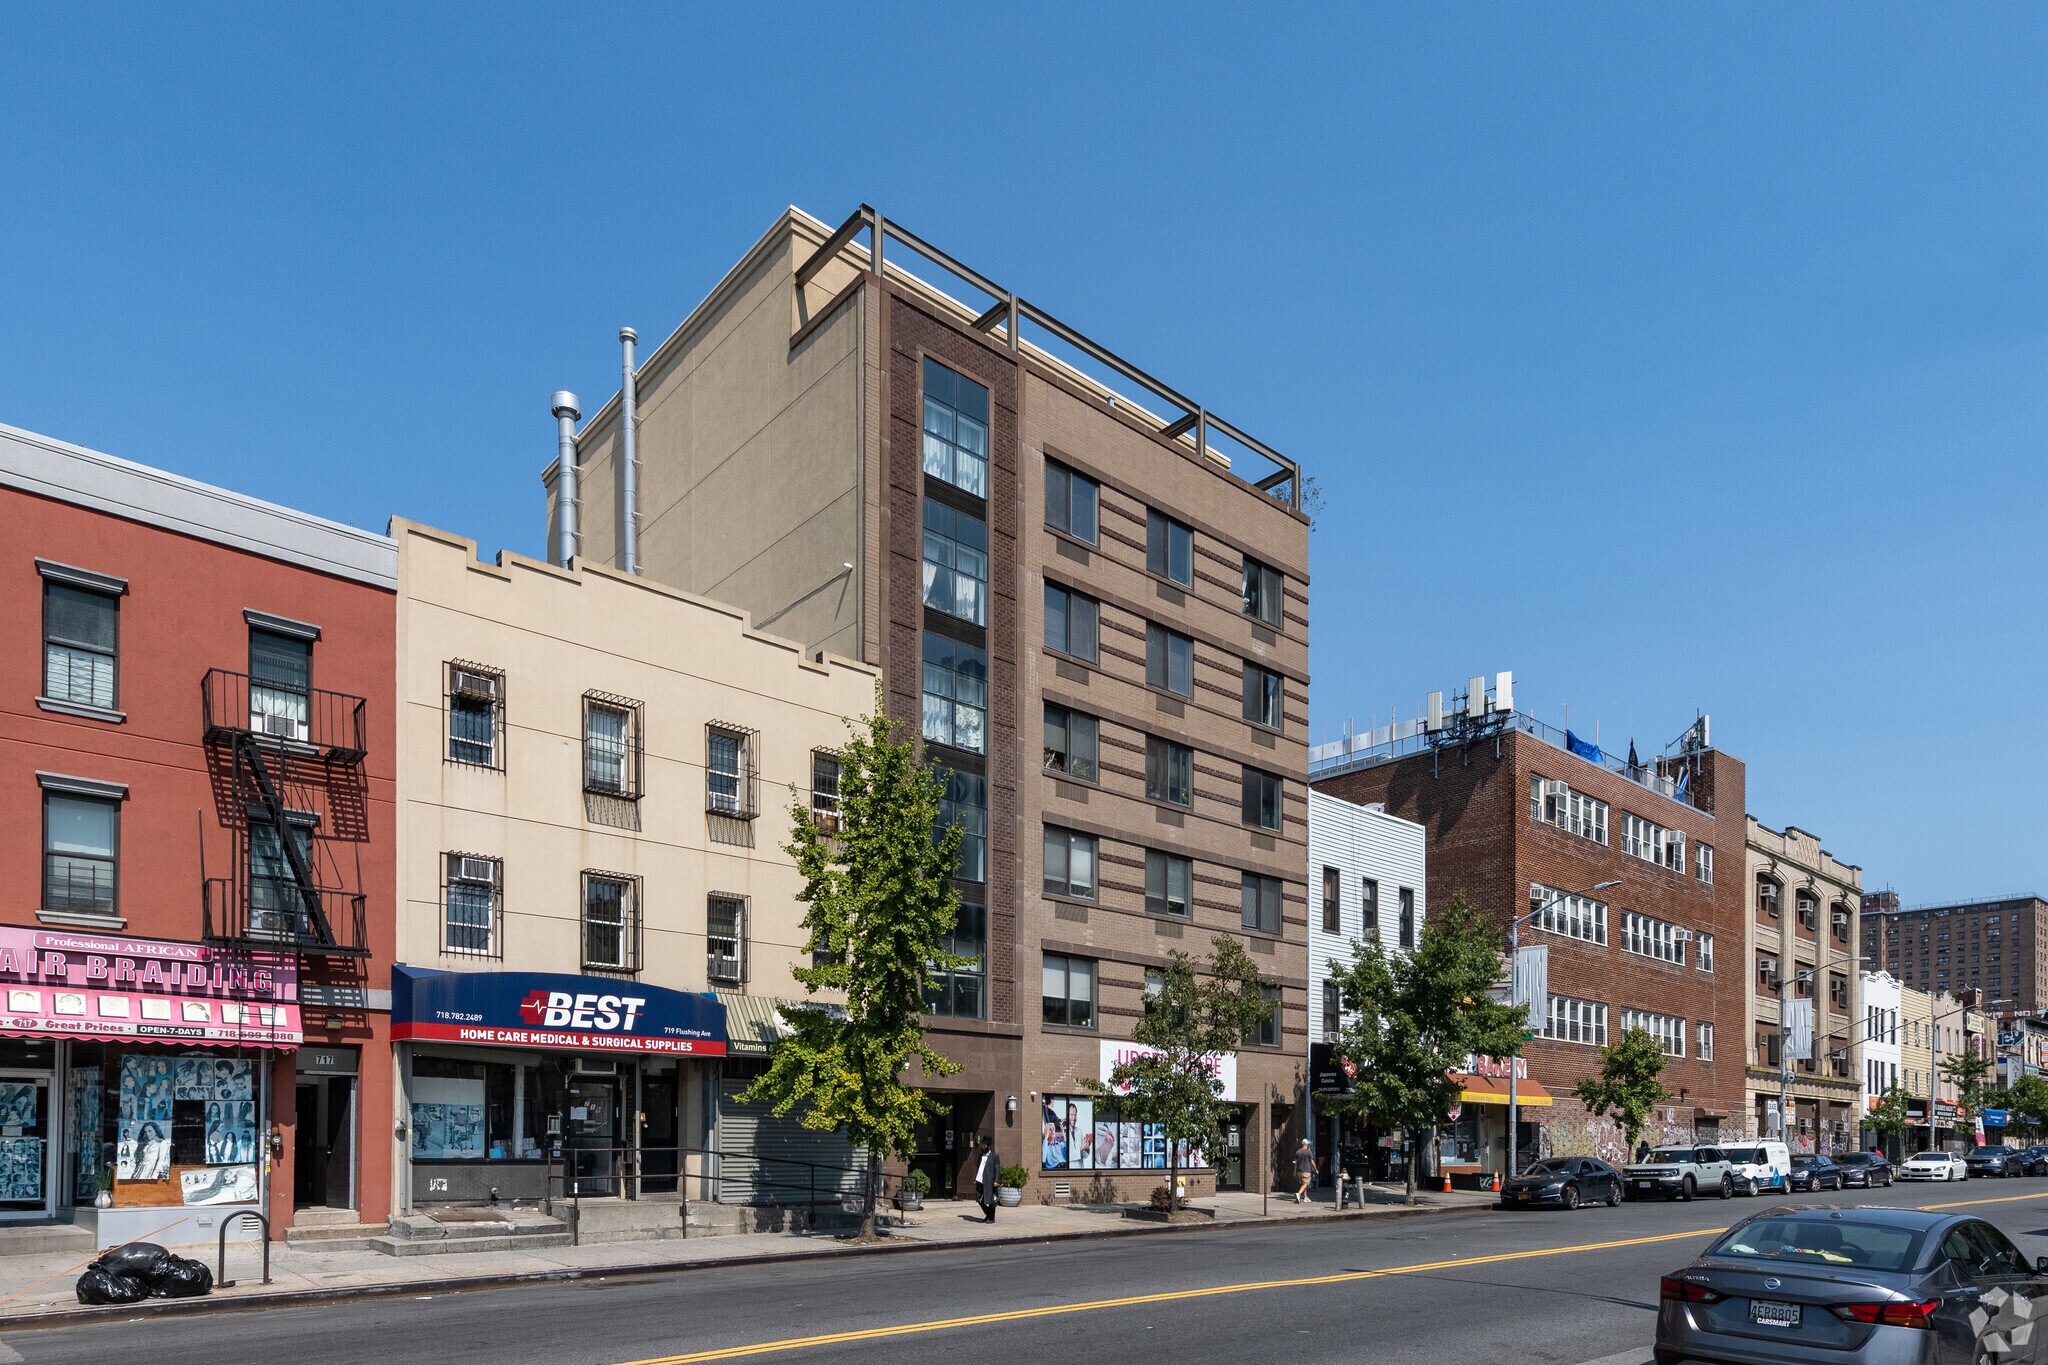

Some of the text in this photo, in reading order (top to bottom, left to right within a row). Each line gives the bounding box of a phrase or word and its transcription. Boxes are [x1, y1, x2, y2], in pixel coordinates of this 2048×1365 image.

[45, 936, 199, 958] Professional AFRICAN
[86, 955, 273, 992] BRAIDING
[436, 1011, 483, 1021] 718.782.2489
[544, 991, 646, 1031] BEST
[18, 1019, 32, 1028] 717
[45, 1020, 81, 1031] Great
[84, 1022, 124, 1032] Prices
[139, 1025, 202, 1036] OPEN-7-DAYS
[217, 1030, 237, 1038] 718
[676, 1028, 700, 1038] Flushing
[460, 1029, 693, 1052] HOME CARE MEDICAL & SURGICAL SUPPLIES
[734, 1042, 767, 1052] Vitamins
[315, 1055, 333, 1064] 717
[1750, 1304, 1800, 1322] 4ER8805
[1756, 1317, 1791, 1328] CARSMART
